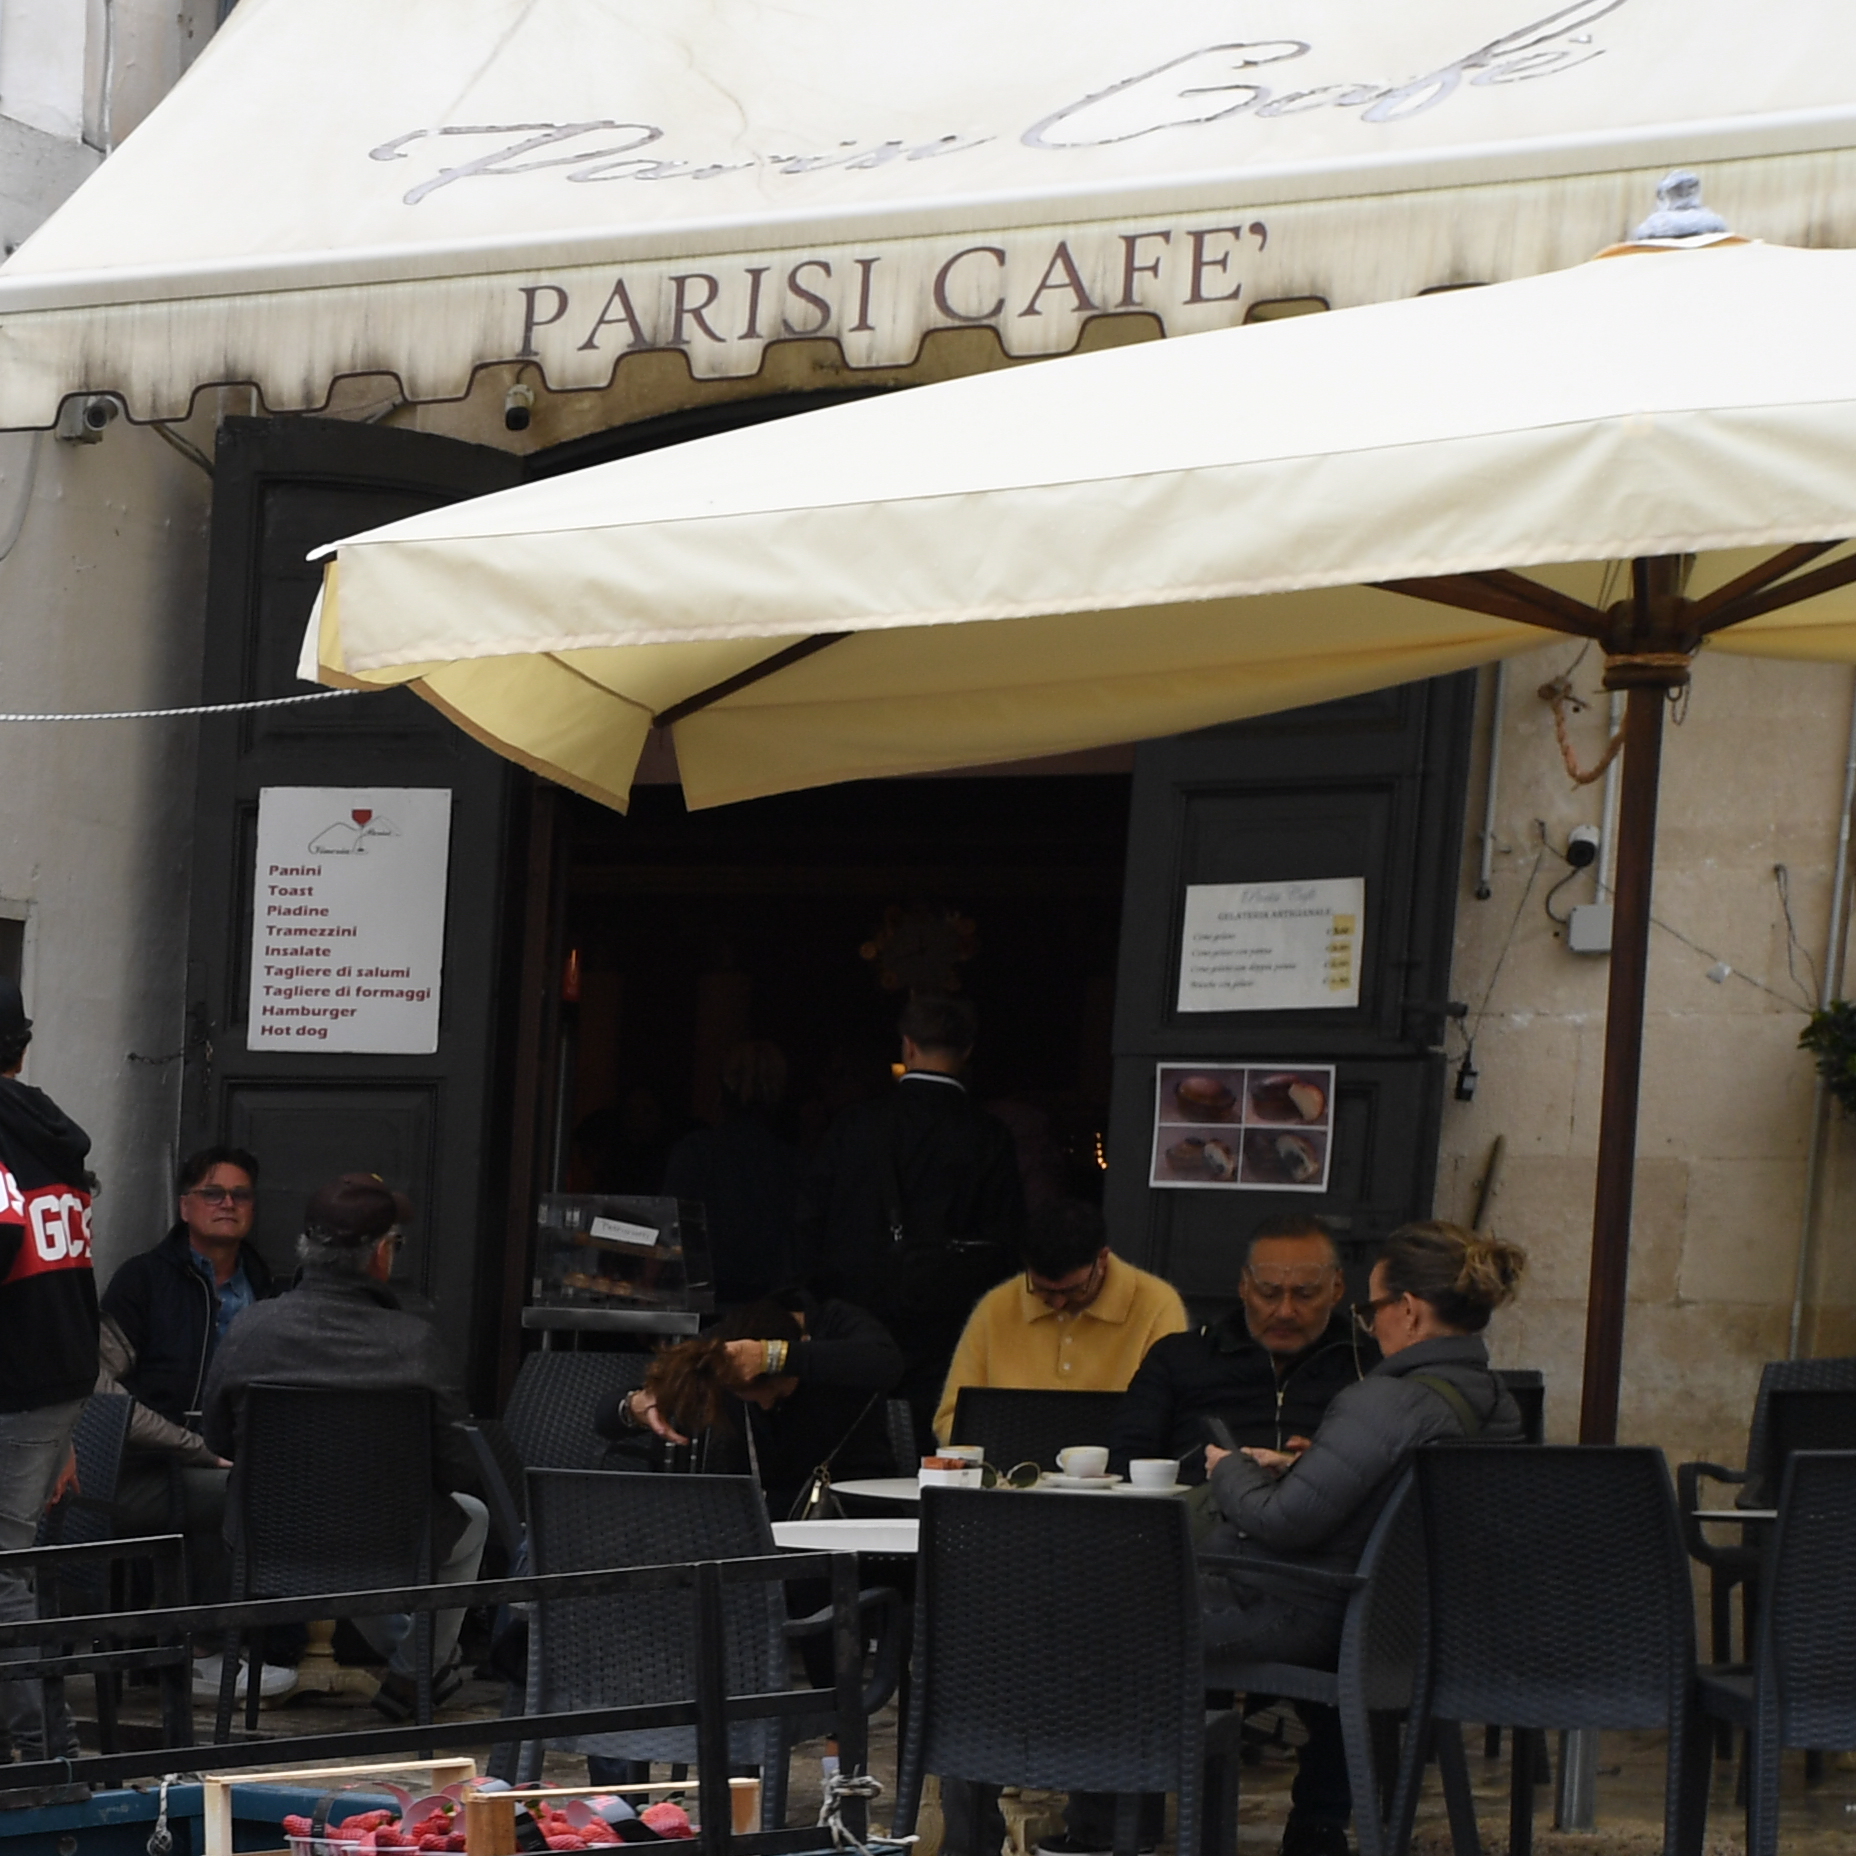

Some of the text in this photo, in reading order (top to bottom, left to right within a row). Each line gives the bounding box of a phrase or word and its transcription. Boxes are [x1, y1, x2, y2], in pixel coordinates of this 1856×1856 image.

[516, 256, 882, 358] PARISI
[268, 864, 322, 877] Panini
[268, 884, 314, 897] Toast
[266, 905, 330, 917] Piadine
[265, 925, 358, 938] Tramezzini
[264, 945, 332, 958] Insalate
[263, 965, 411, 980] Tagliere di salumi
[262, 985, 431, 1002] Tagliere di formaggi
[261, 1005, 358, 1020] Hamburger
[260, 1025, 329, 1040] Hot dog
